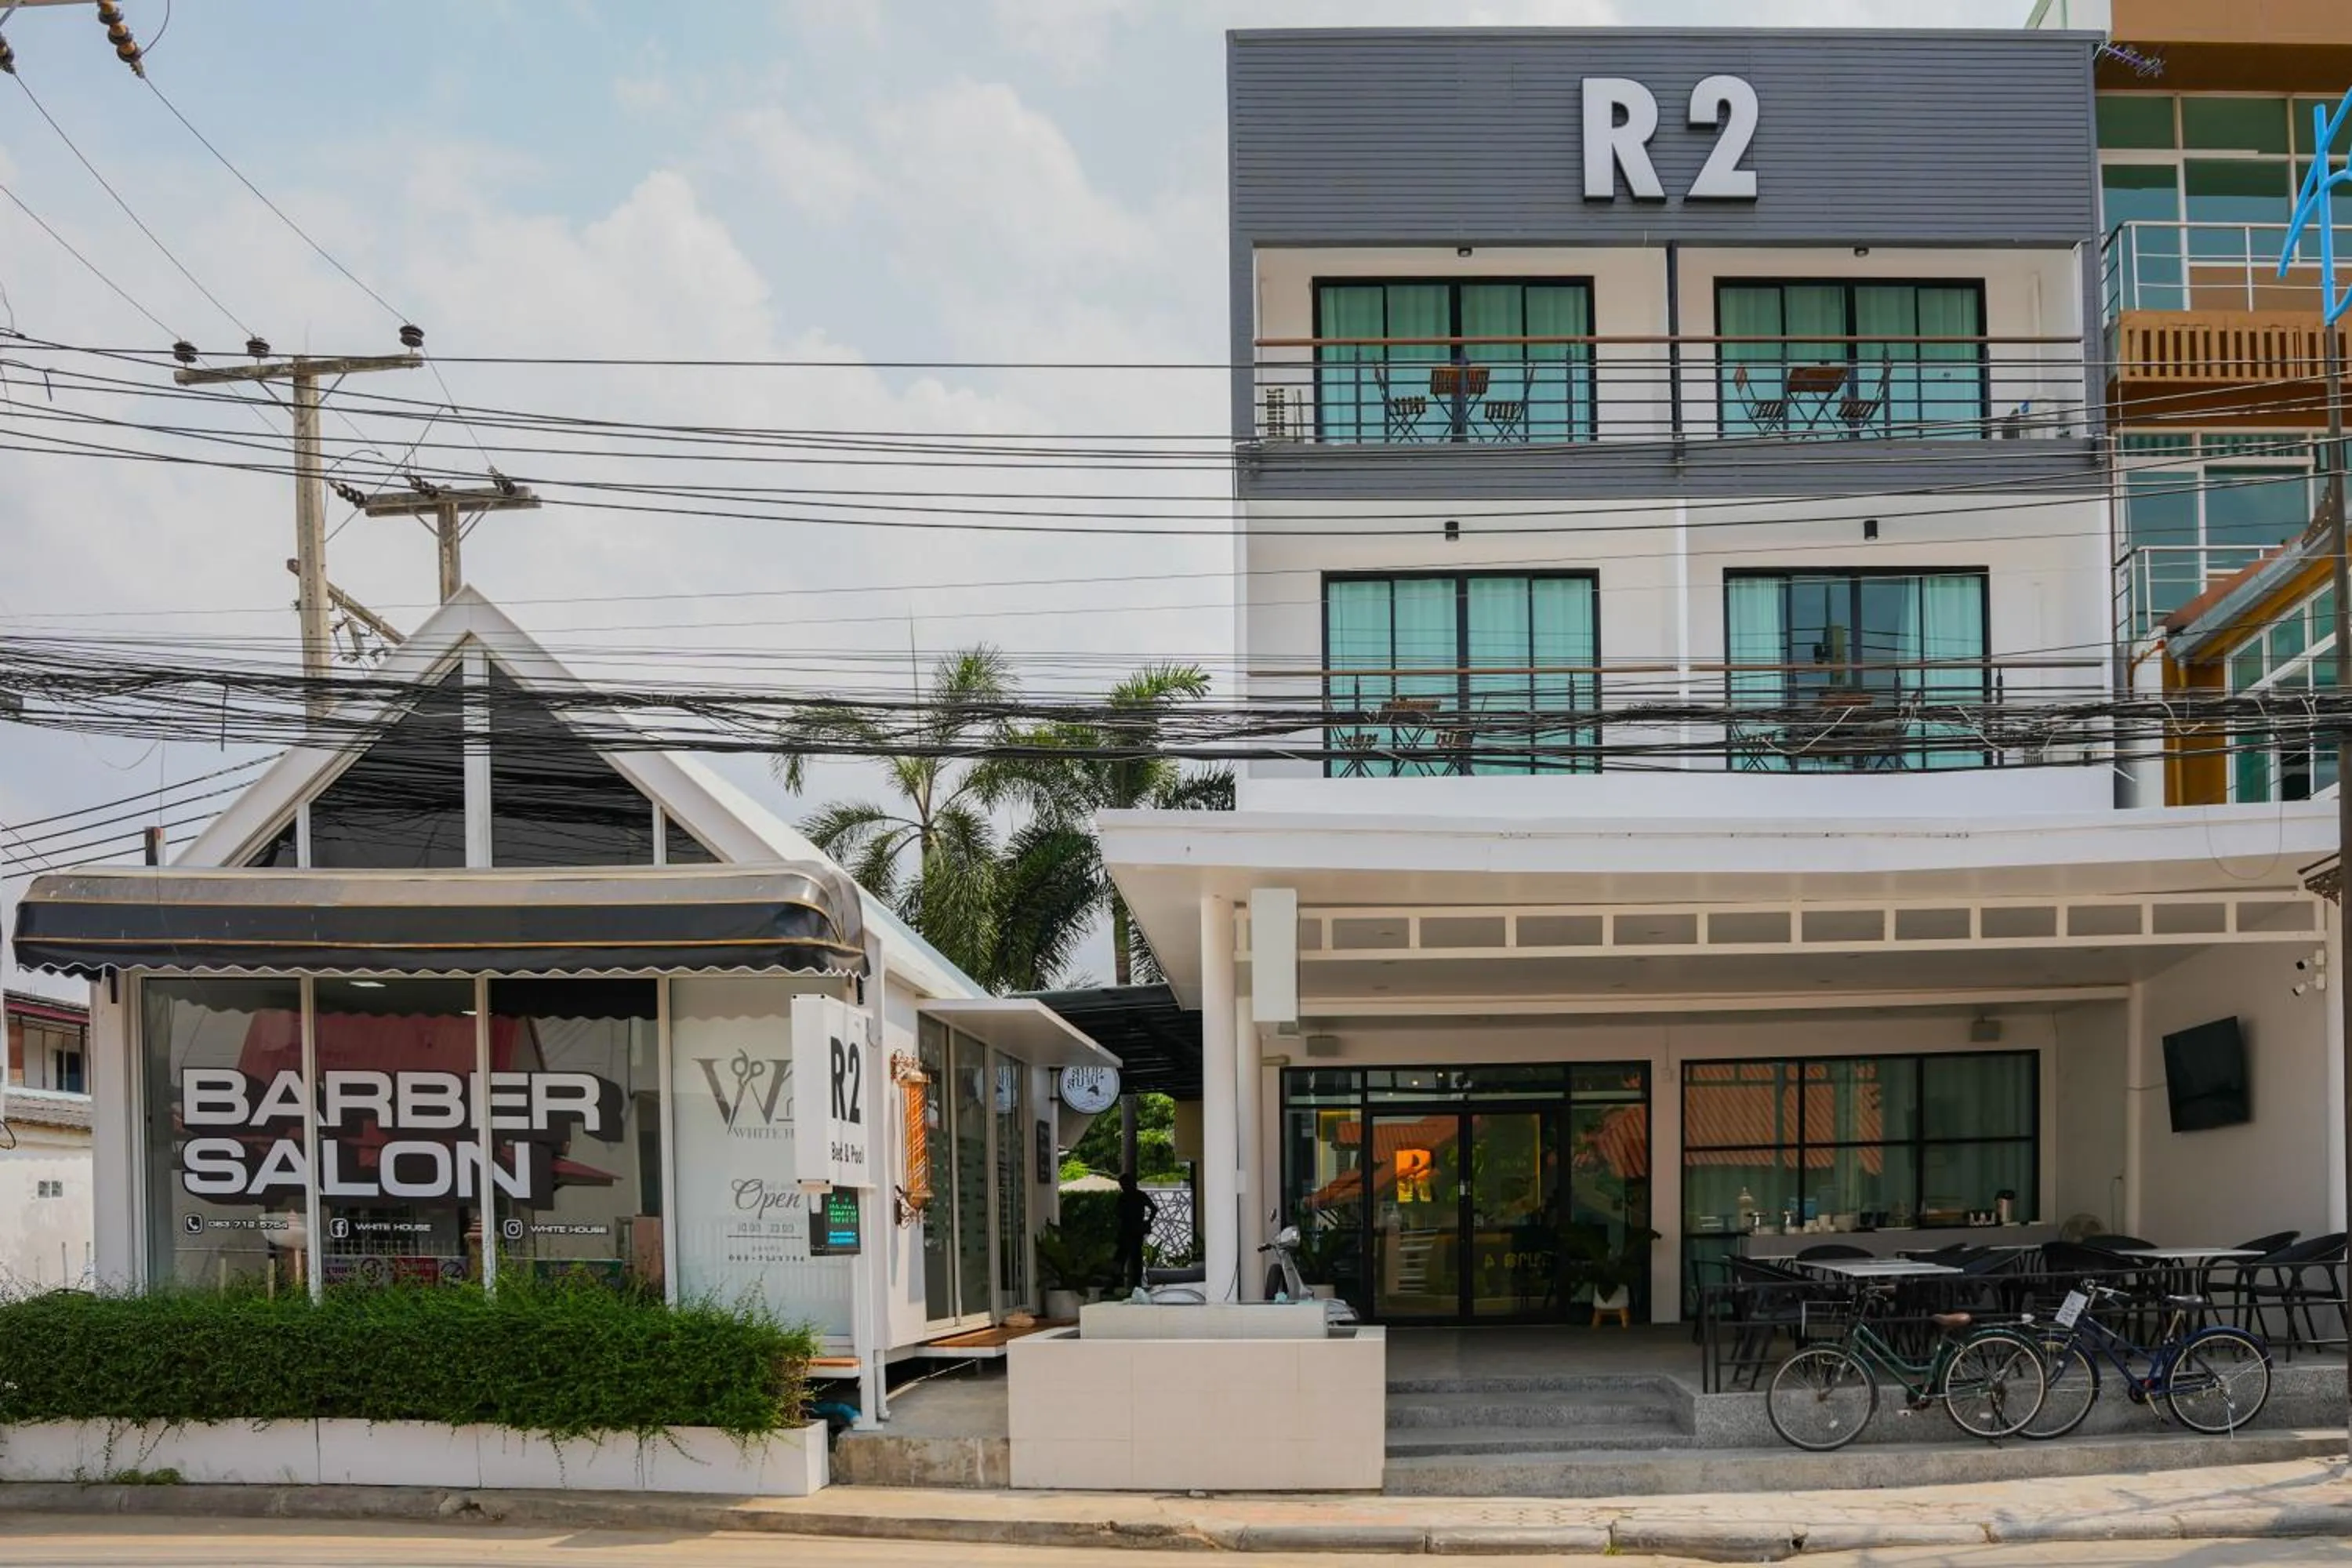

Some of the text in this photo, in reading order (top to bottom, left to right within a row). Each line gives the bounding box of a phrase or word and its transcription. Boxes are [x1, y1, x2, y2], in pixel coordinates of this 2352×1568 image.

[181, 1068, 602, 1131] BARBER
[830, 1036, 861, 1124] R2
[183, 1137, 532, 1200] SALON
[731, 1178, 800, 1220] Open
[354, 1222, 432, 1232] WHITE HOUSE
[529, 1224, 608, 1234] WHITE HOUSE
